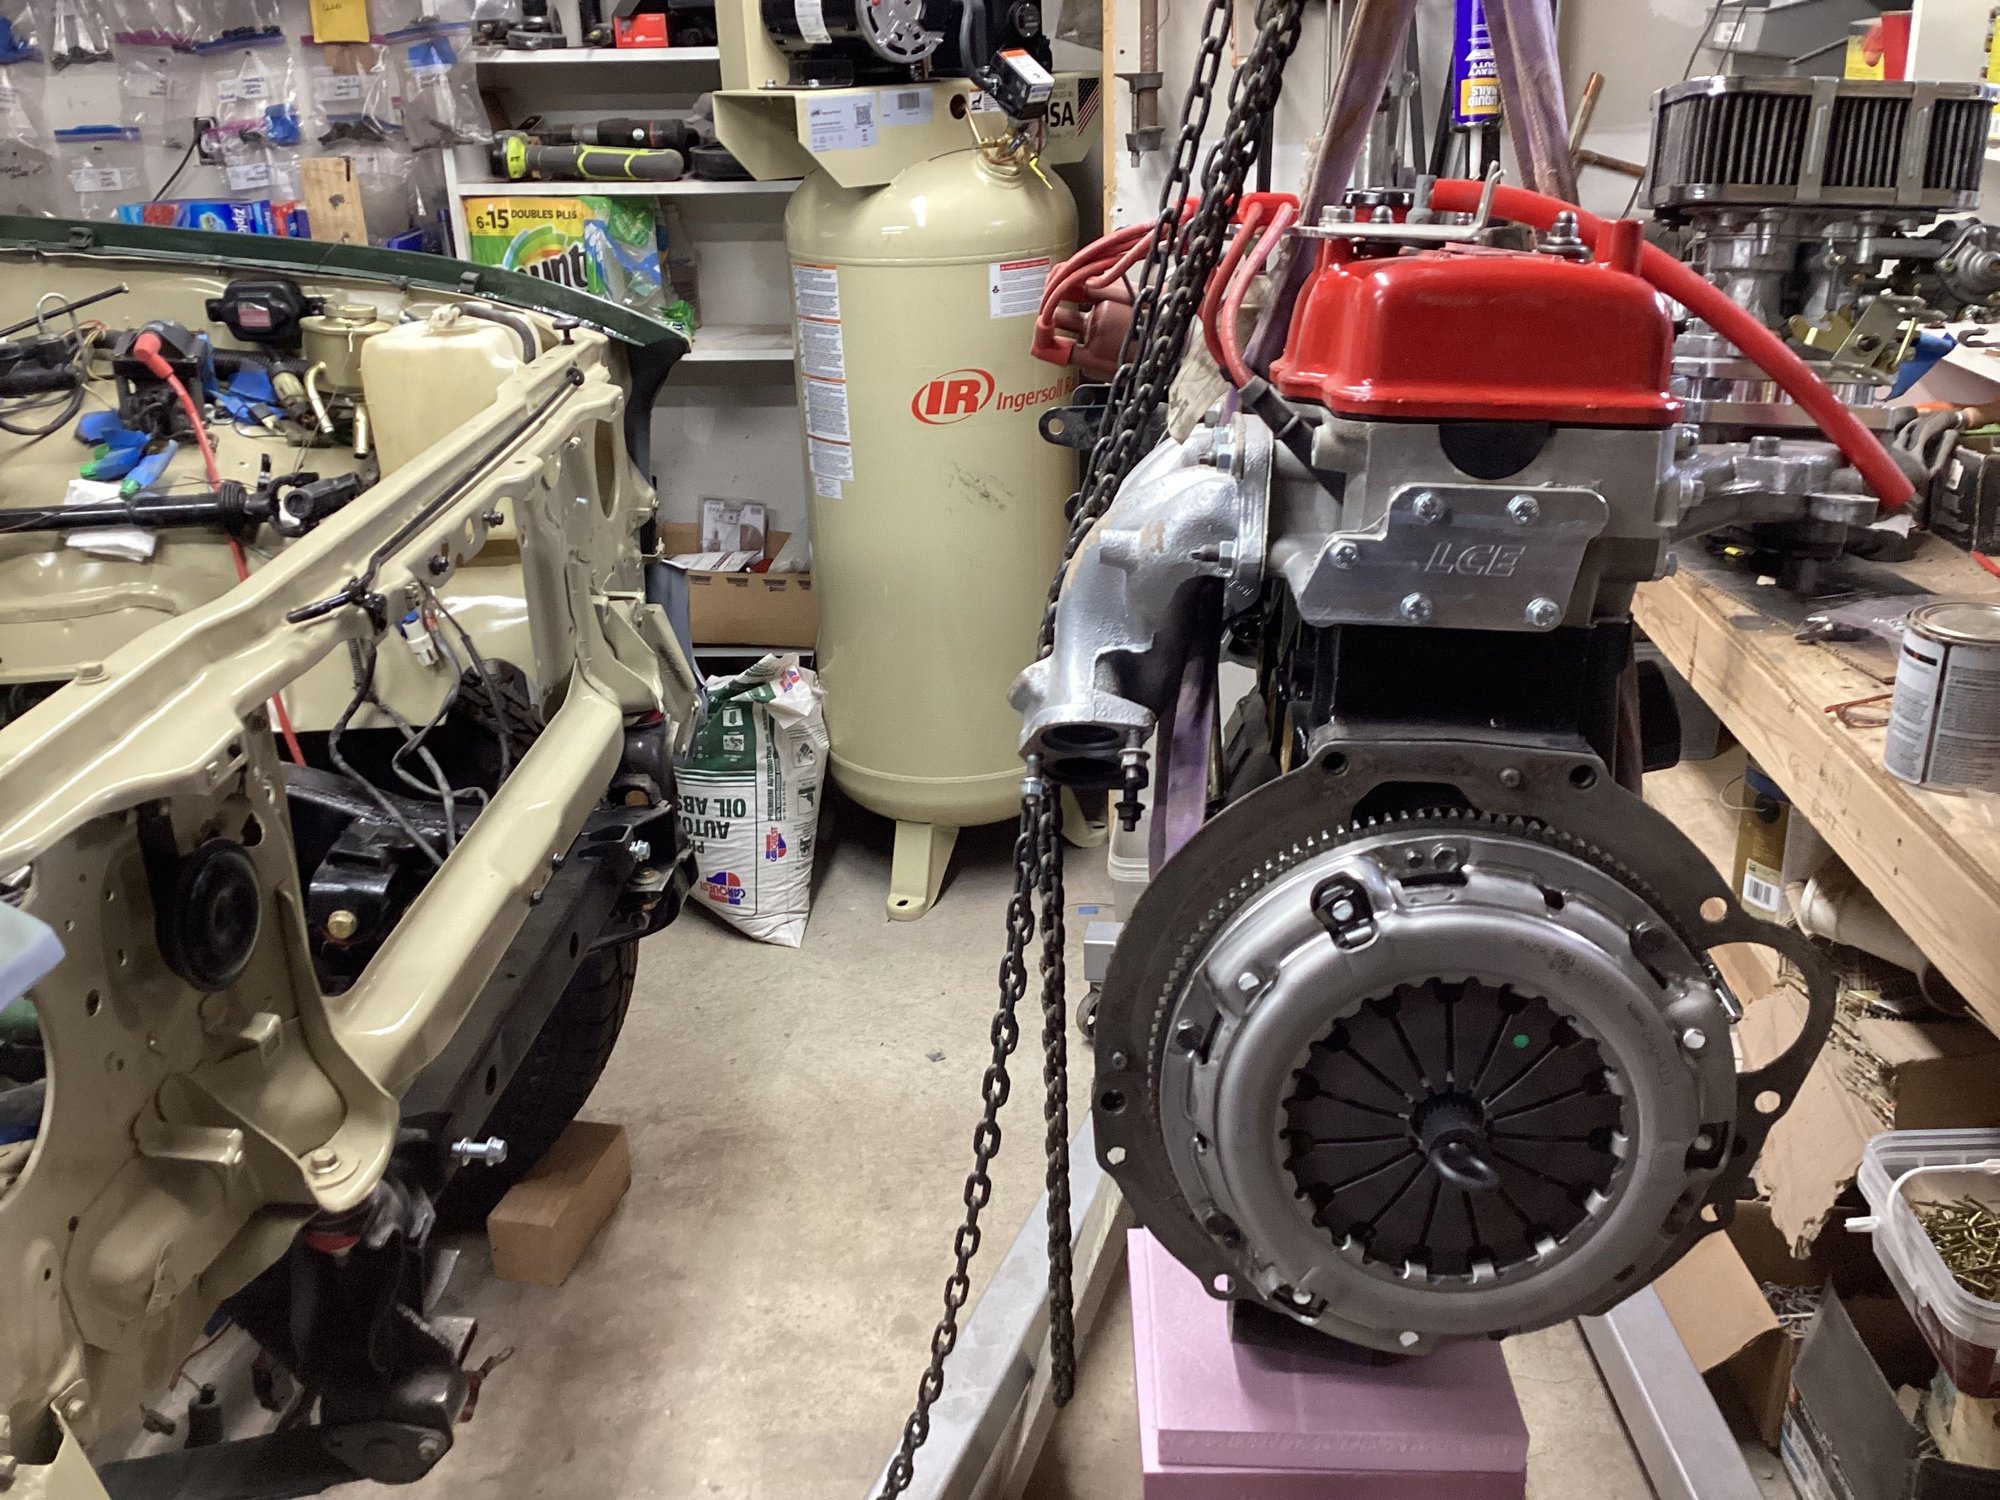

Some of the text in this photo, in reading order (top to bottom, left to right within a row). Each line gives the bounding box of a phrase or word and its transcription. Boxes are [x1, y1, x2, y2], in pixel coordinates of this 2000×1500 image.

[1471, 85, 1498, 96] NAILS
[1042, 101, 1075, 128] SA
[511, 209, 554, 220] DOUBLES
[925, 379, 981, 415] IR
[996, 378, 1063, 412] Ingersoll
[1424, 543, 1526, 577] LCE
[714, 798, 747, 818] OIL
[678, 816, 730, 840] AUTO
[769, 825, 778, 863] CARQUEST
[700, 880, 746, 899] CARQUEST
